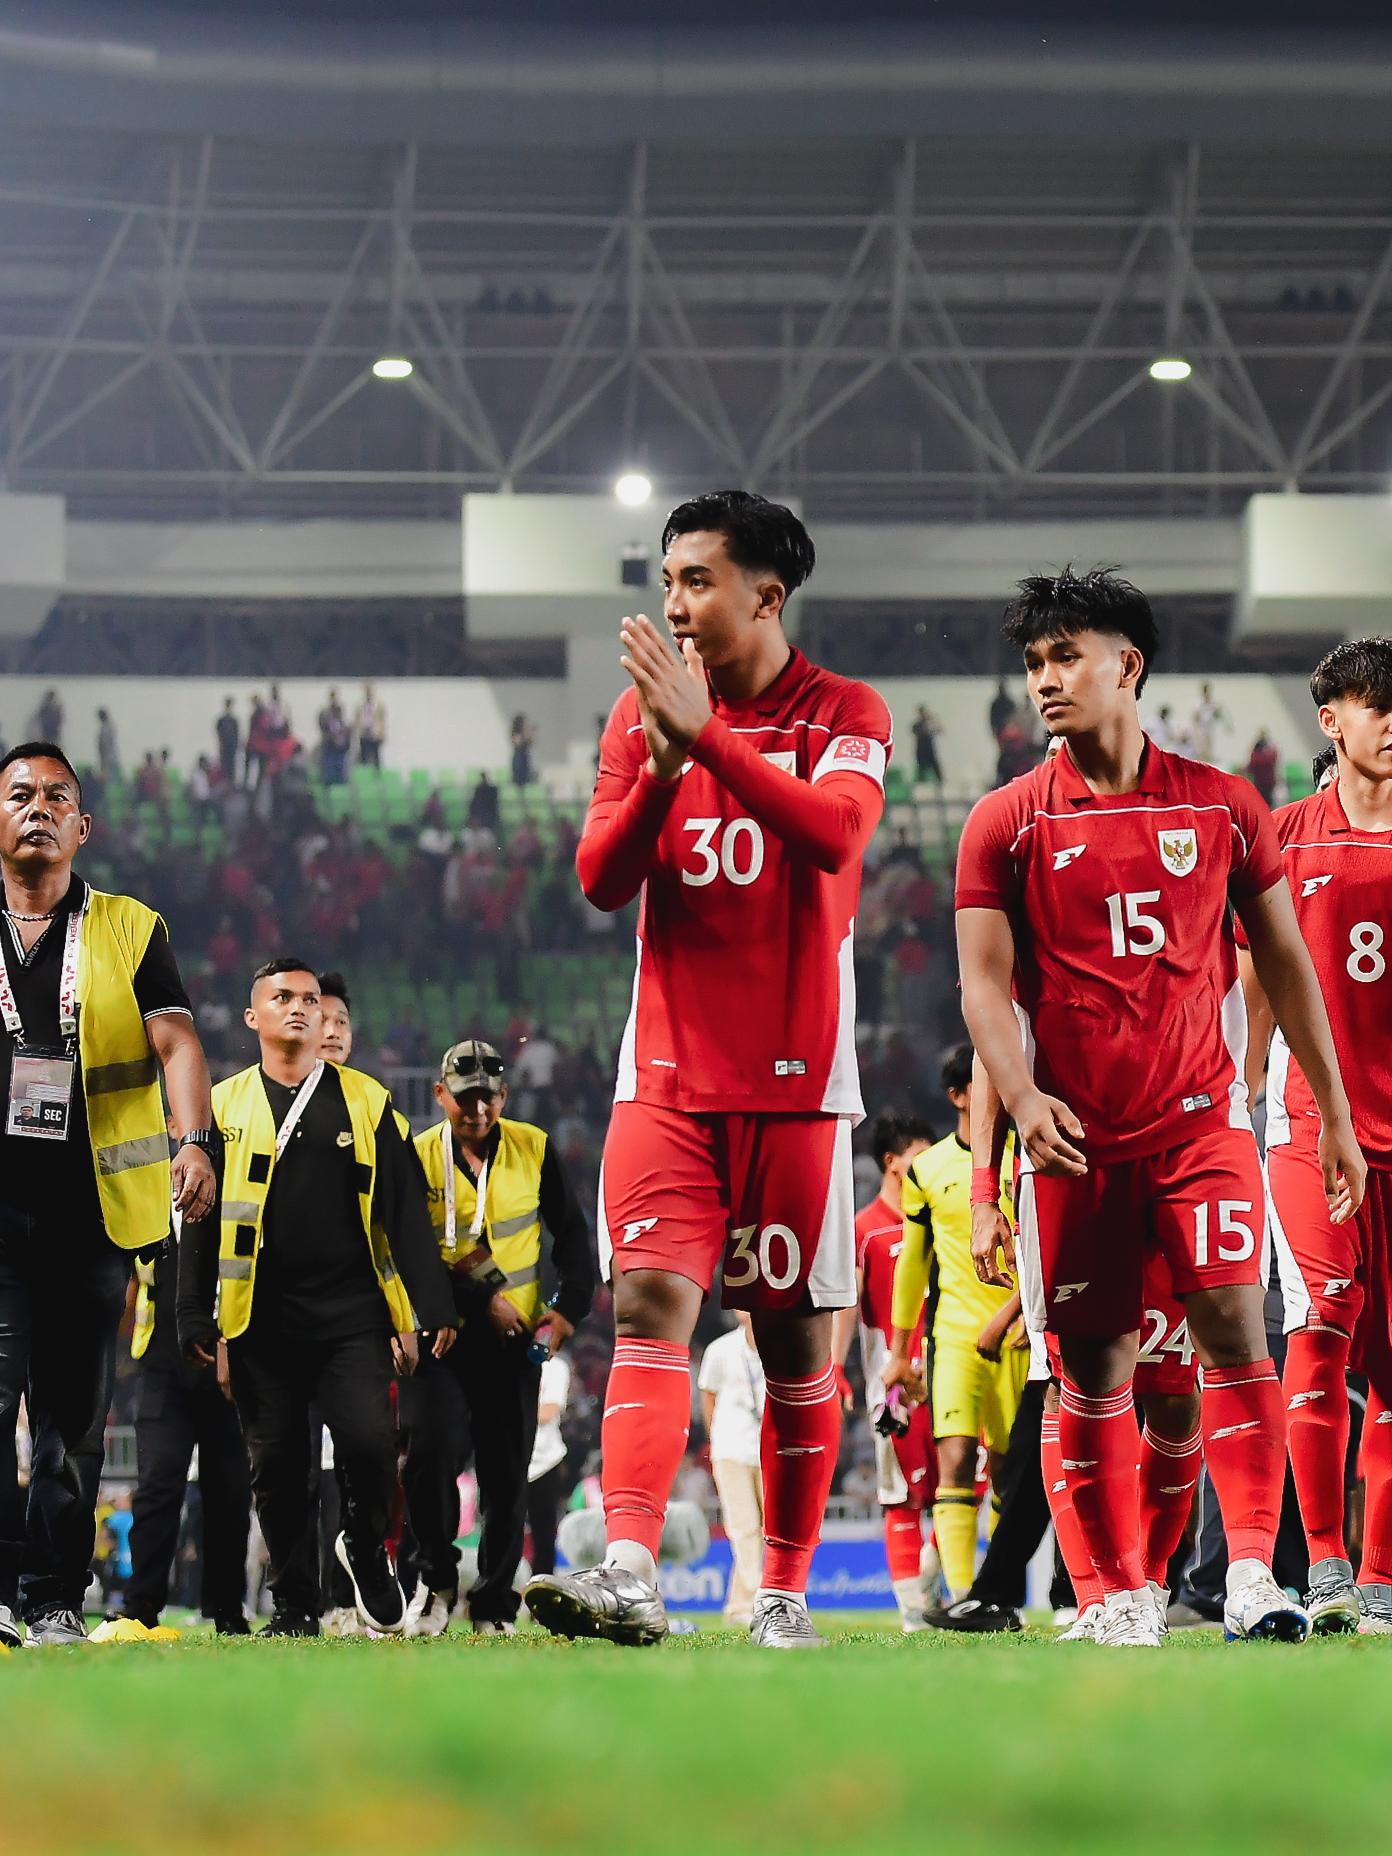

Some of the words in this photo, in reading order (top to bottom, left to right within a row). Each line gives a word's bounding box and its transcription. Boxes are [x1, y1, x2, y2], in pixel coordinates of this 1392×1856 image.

[682, 817, 765, 887] 30
[1104, 889, 1166, 958] 15
[1346, 921, 1386, 983] 8
[44, 1109, 62, 1122] SEC
[723, 1223, 801, 1290] 30
[1192, 1199, 1255, 1267] 15
[1137, 1309, 1197, 1366] 24
